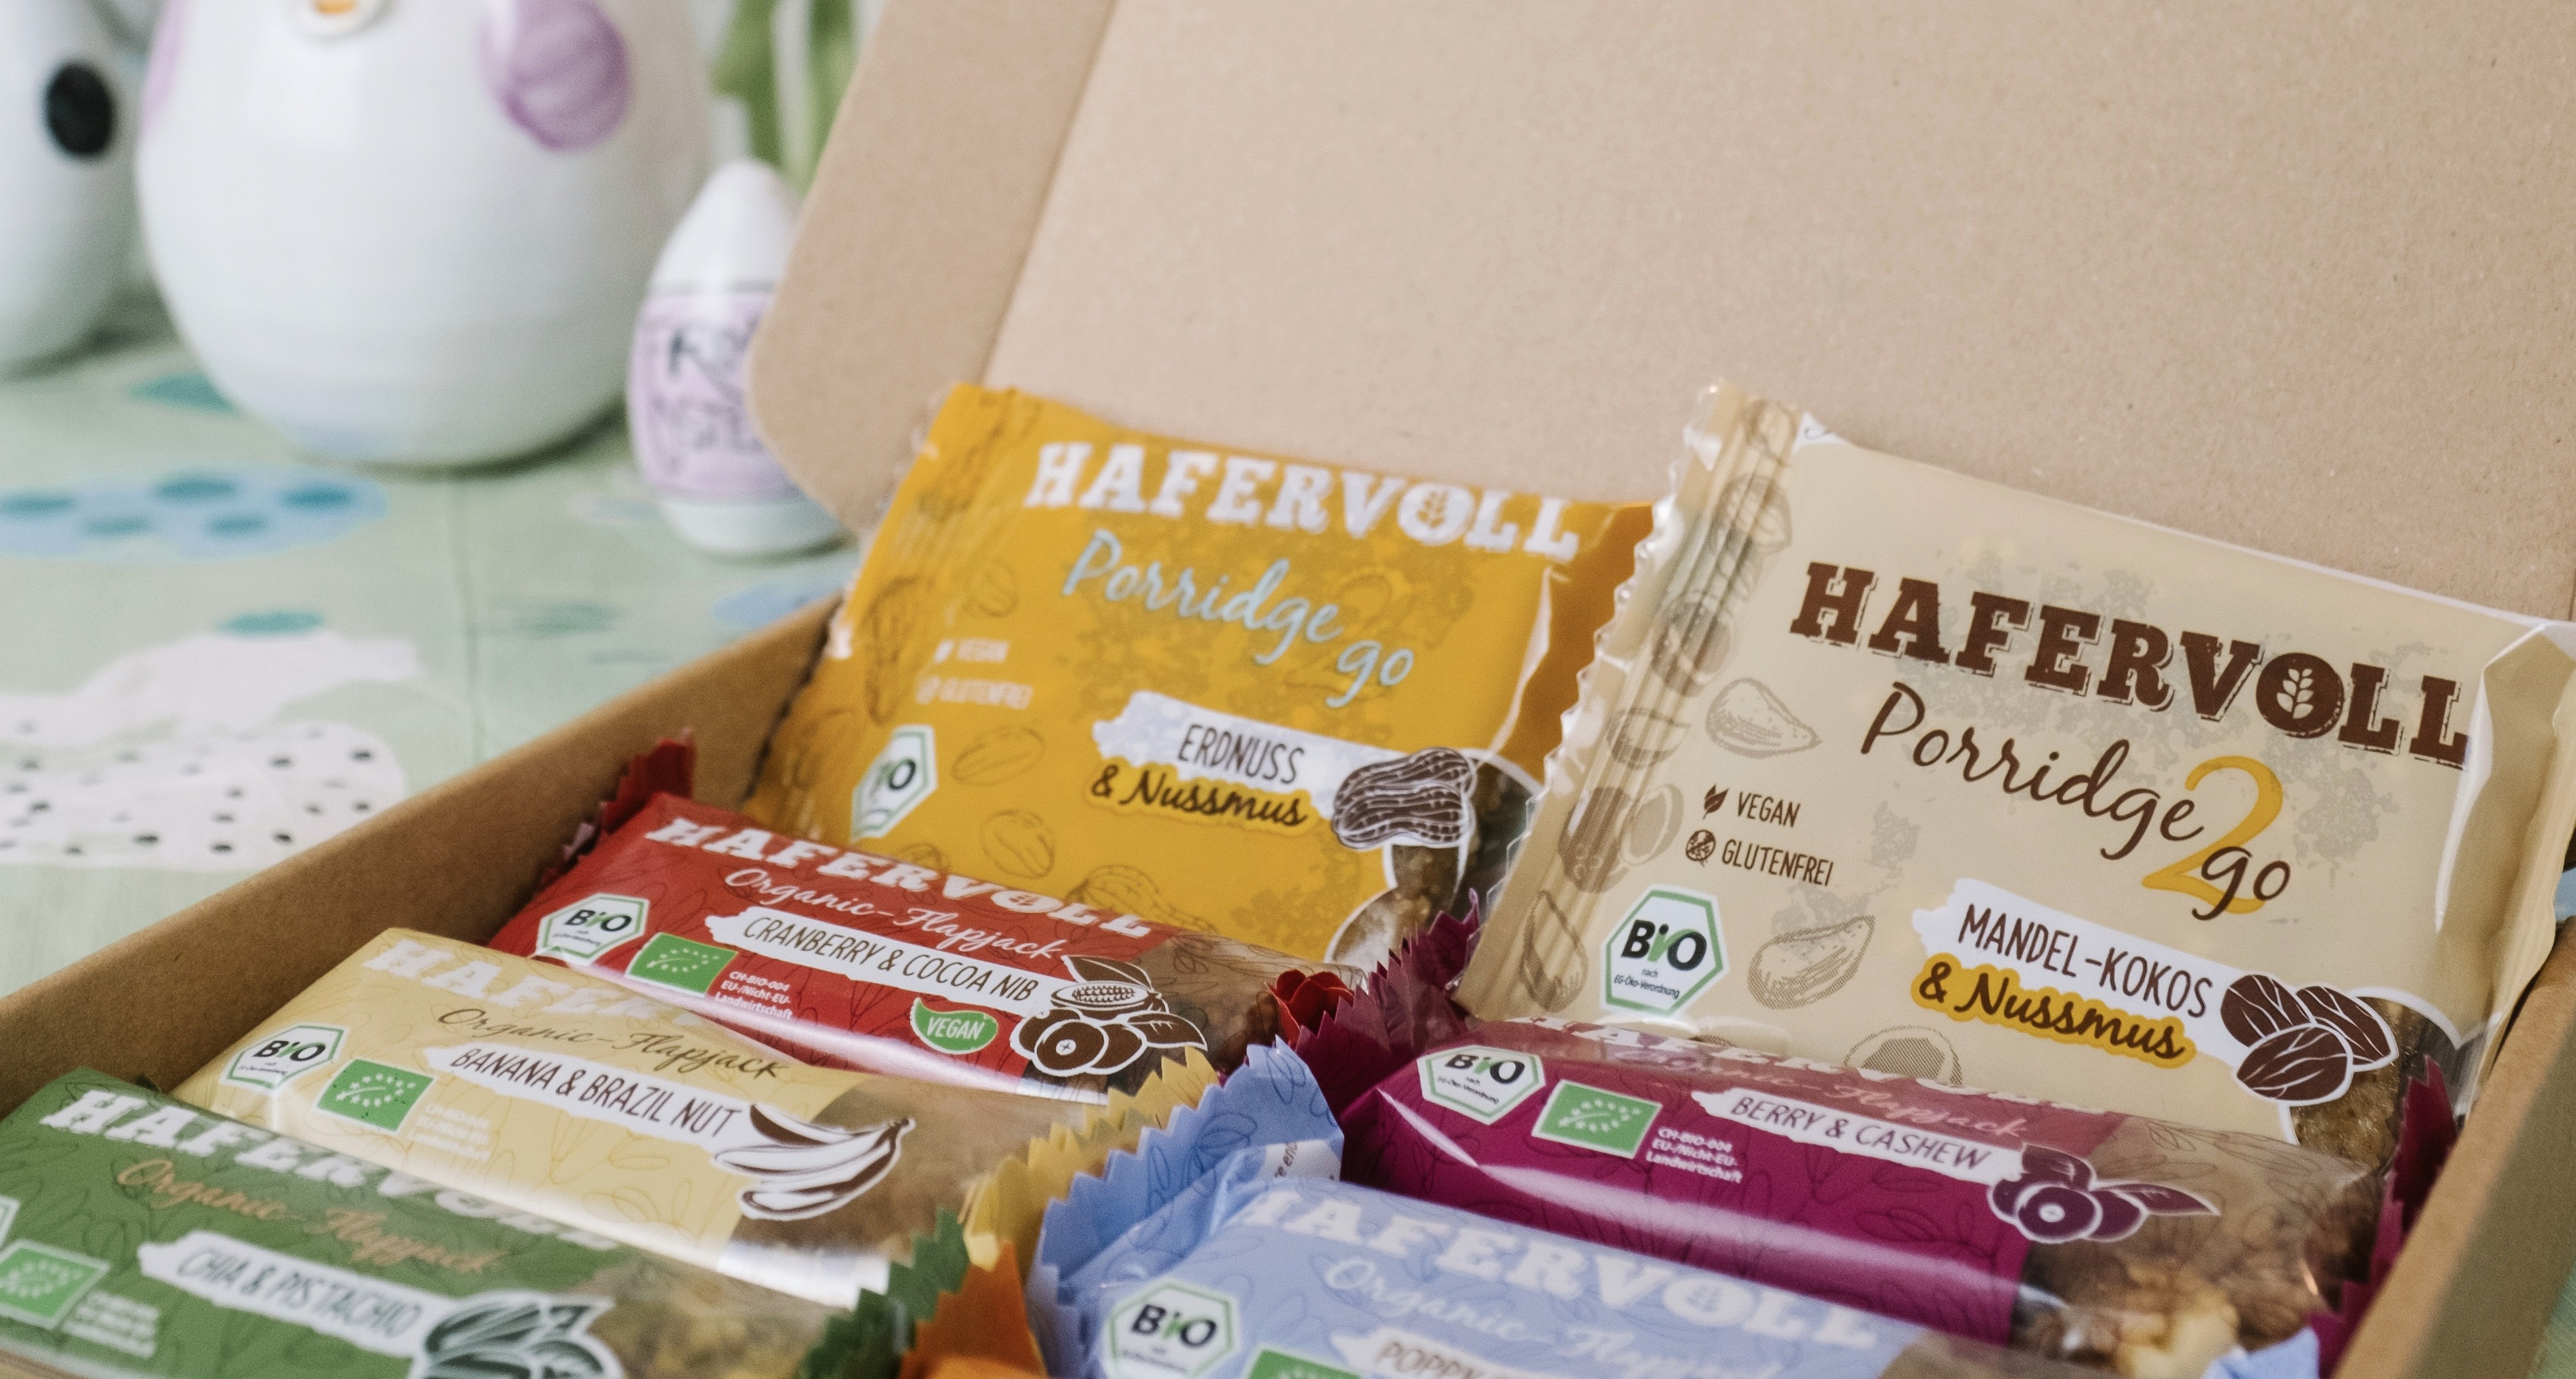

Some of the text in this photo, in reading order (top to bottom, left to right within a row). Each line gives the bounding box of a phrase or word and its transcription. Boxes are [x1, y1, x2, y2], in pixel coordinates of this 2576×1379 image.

[1023, 442, 1580, 561] HAFERVOLL
[1061, 528, 1343, 666] Porridge
[1325, 639, 1415, 708] go
[1790, 561, 2470, 771] HAFERVOLL
[1090, 764, 1309, 827] & Nussmus
[1177, 722, 1304, 785] ERDNUSS
[1737, 791, 1801, 829] VEGAN
[1861, 680, 2291, 921] Porridge 2 go
[645, 817, 1151, 938] HAFERVOLL
[1721, 839, 1834, 887] GLUTENFREI
[743, 916, 1040, 1002] CRANBERRY & COCOA NIB
[1642, 968, 1659, 979] nach
[1958, 903, 2214, 1018] MANDEL-KOKOS
[926, 1016, 986, 1041] VEGAN
[1919, 961, 2186, 1060] & Nussmus
[450, 1047, 743, 1138] BANANA & BRAZIL NUT
[1730, 1097, 1993, 1171] BERRY & CASHEW
